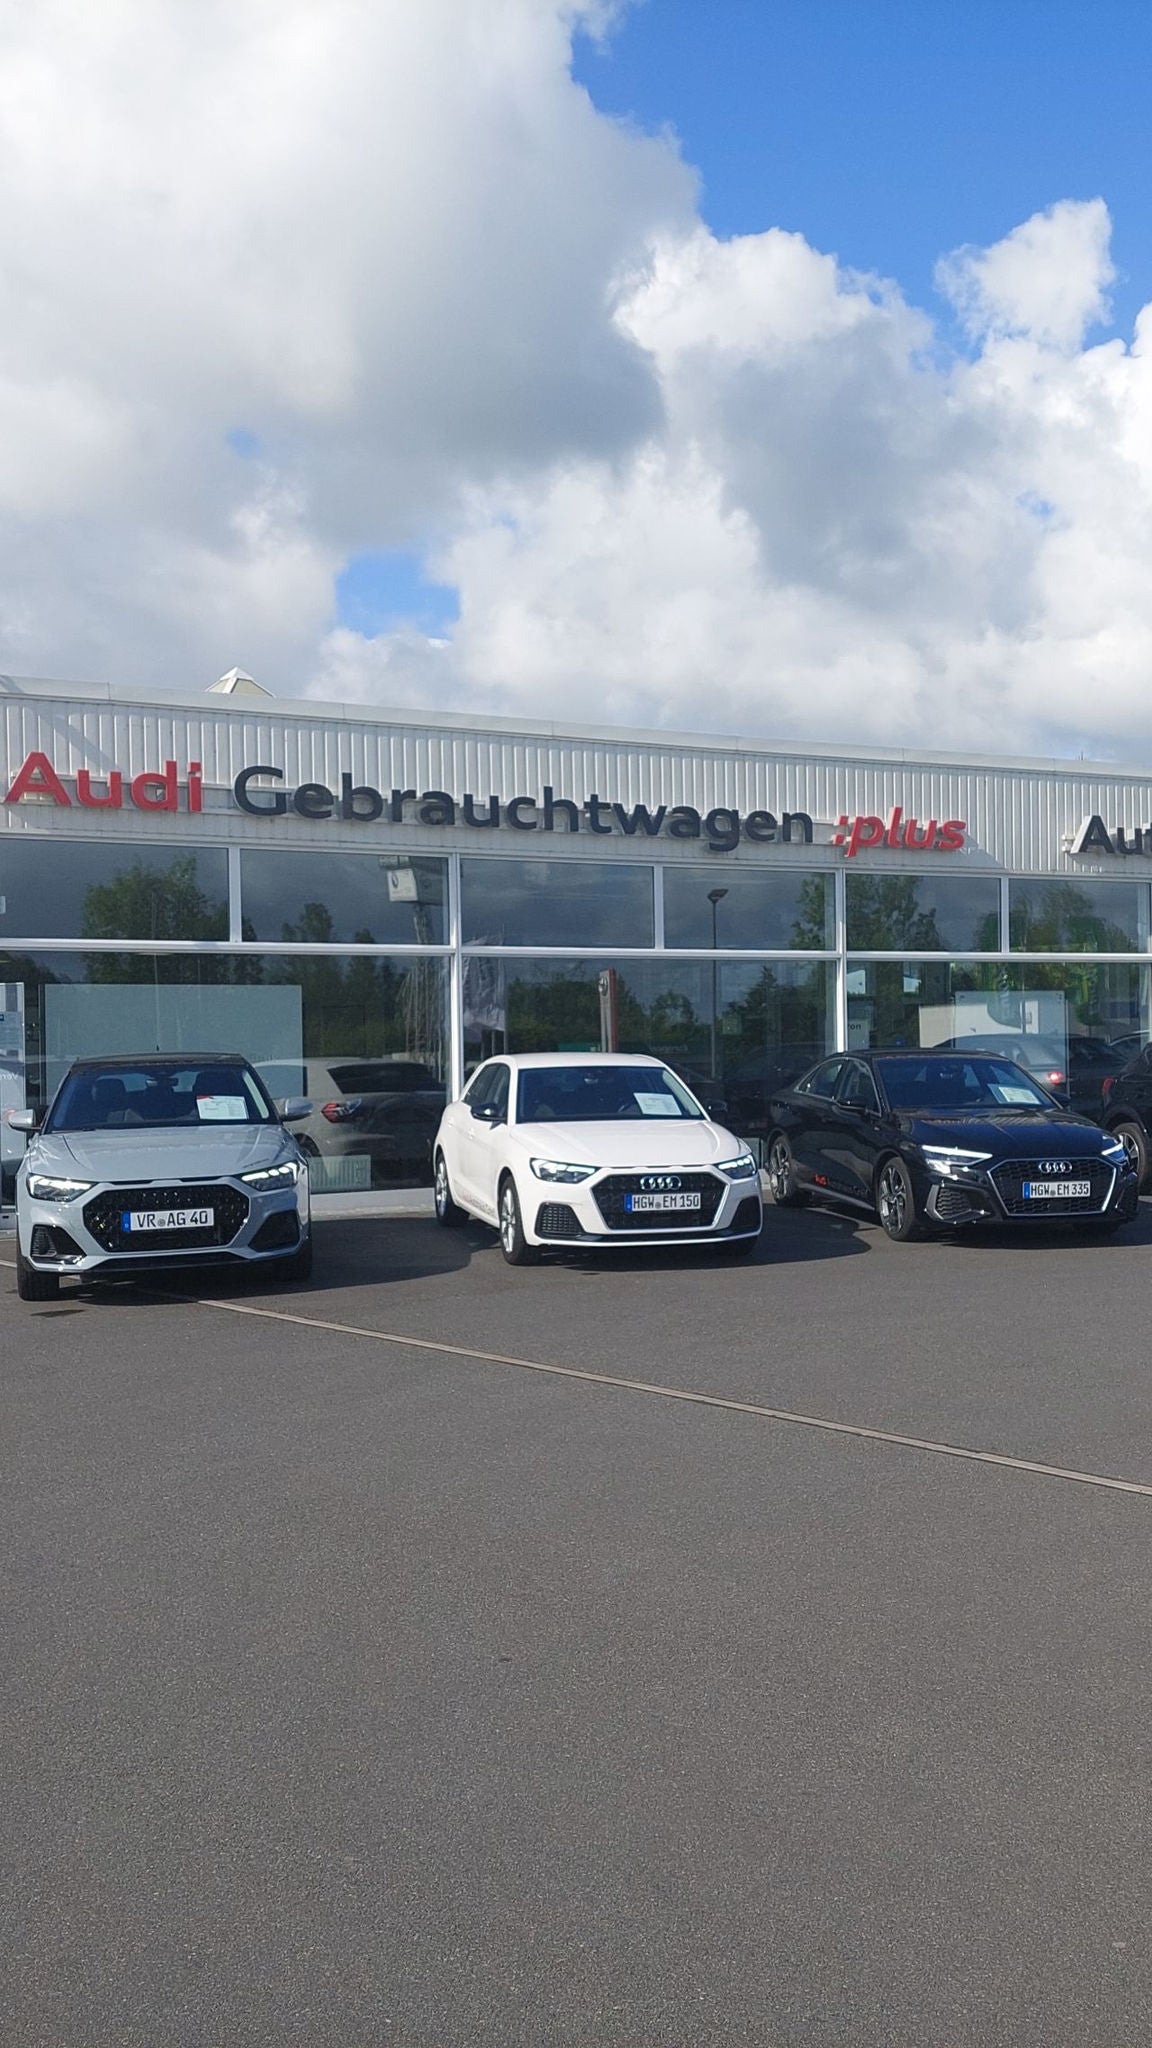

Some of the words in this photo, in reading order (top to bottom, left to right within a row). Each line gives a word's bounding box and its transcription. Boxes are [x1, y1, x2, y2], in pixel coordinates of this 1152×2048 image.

[5, 751, 201, 812] Audi
[233, 765, 813, 851] Gebrauchtwagen
[832, 806, 967, 858] :plus
[1030, 1184, 1050, 1196] HGW
[1057, 1183, 1070, 1196] EM
[1071, 1183, 1089, 1195] 335
[633, 1196, 655, 1209] HGW
[662, 1195, 677, 1208] EM
[680, 1194, 699, 1208] 150
[137, 1213, 156, 1228] VR
[167, 1212, 186, 1226] AG
[190, 1210, 208, 1225] 40
